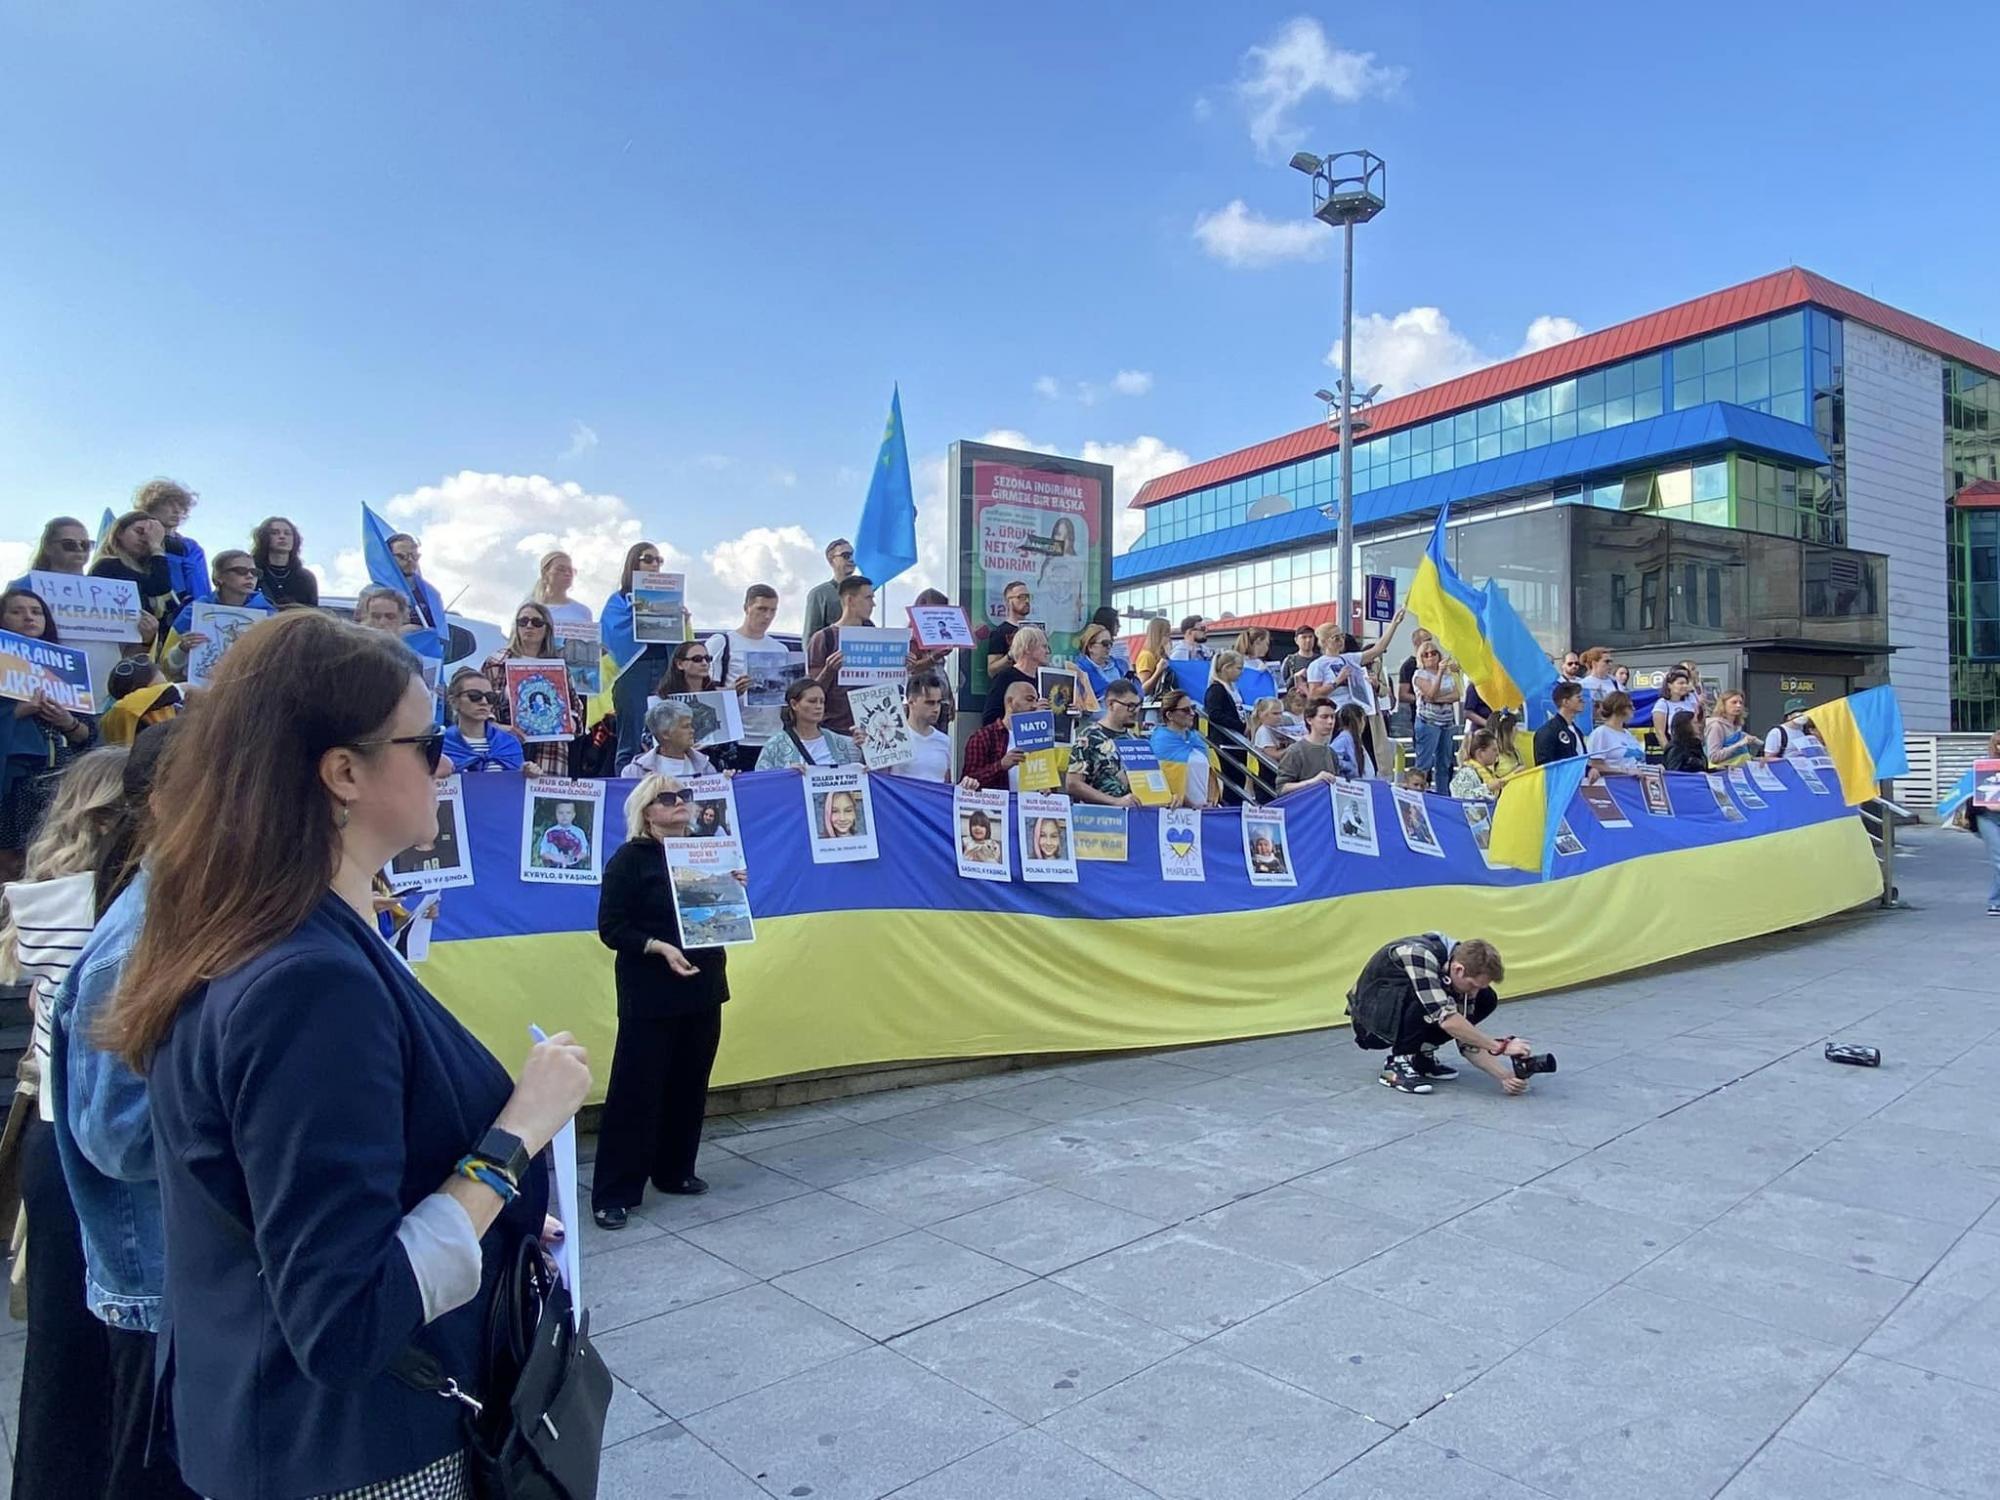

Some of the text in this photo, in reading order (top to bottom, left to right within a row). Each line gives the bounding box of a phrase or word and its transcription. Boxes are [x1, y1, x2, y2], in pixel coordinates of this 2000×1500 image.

[993, 475, 1032, 490] SEZONA
[992, 488, 1085, 511] GİRMEK BİR BAŞKA
[985, 527, 995, 537] 2.
[985, 541, 1007, 553] NET
[984, 556, 1036, 572] İNDİRİM!
[0, 638, 74, 672] UKRAINE
[1020, 721, 1047, 732] NATO
[1028, 758, 1046, 773] WE
[1167, 811, 1192, 826] SAVE
